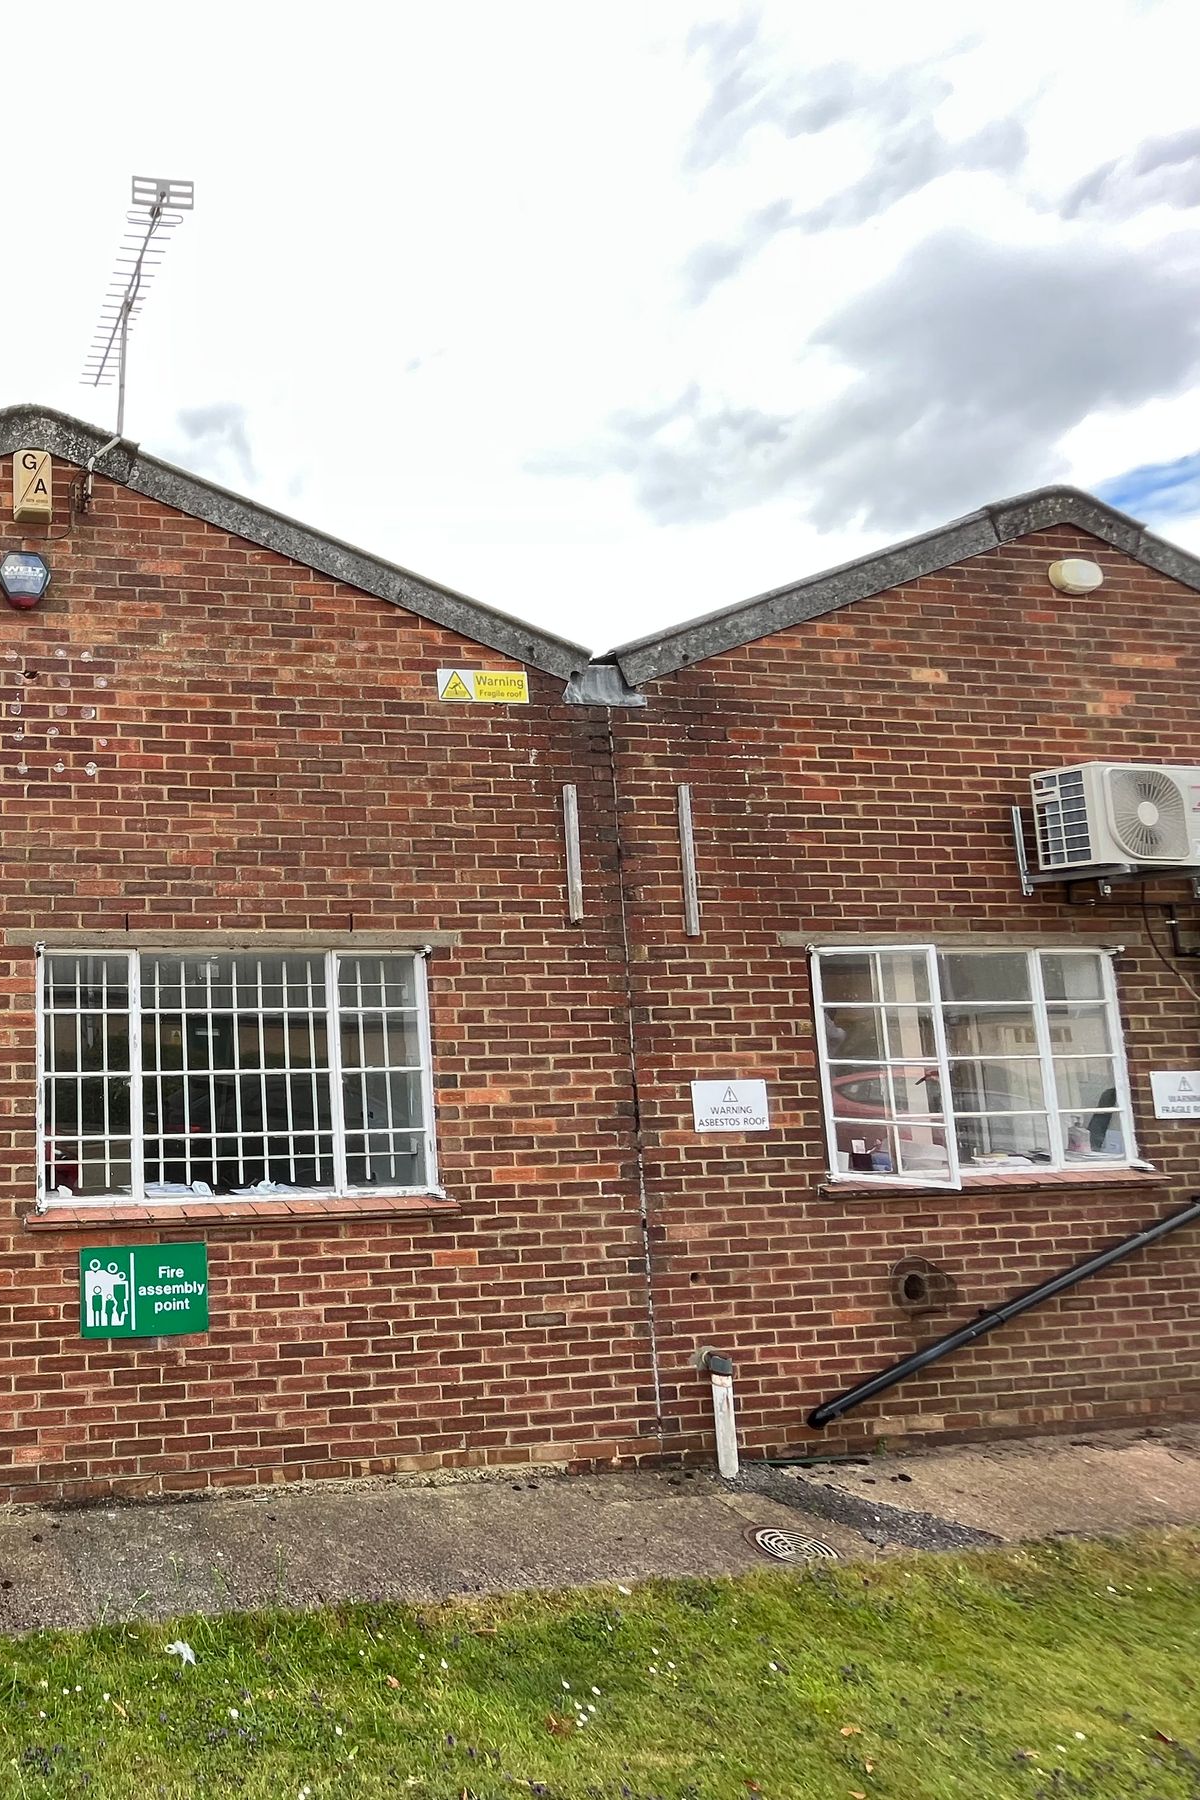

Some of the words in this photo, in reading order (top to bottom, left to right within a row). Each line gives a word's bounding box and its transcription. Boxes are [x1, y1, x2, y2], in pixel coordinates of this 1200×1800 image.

[475, 675, 524, 690] Warning
[479, 689, 505, 699] Fragile
[506, 690, 522, 699] roof
[1167, 1094, 1200, 1103] WARNIN
[710, 1106, 753, 1115] WARNING
[1161, 1105, 1192, 1114] FRAGILE
[698, 1117, 741, 1127] ASBESTOS
[743, 1116, 767, 1126] ROOF
[158, 1266, 185, 1279] Fire
[138, 1280, 206, 1296] assembly
[154, 1297, 191, 1315] point
